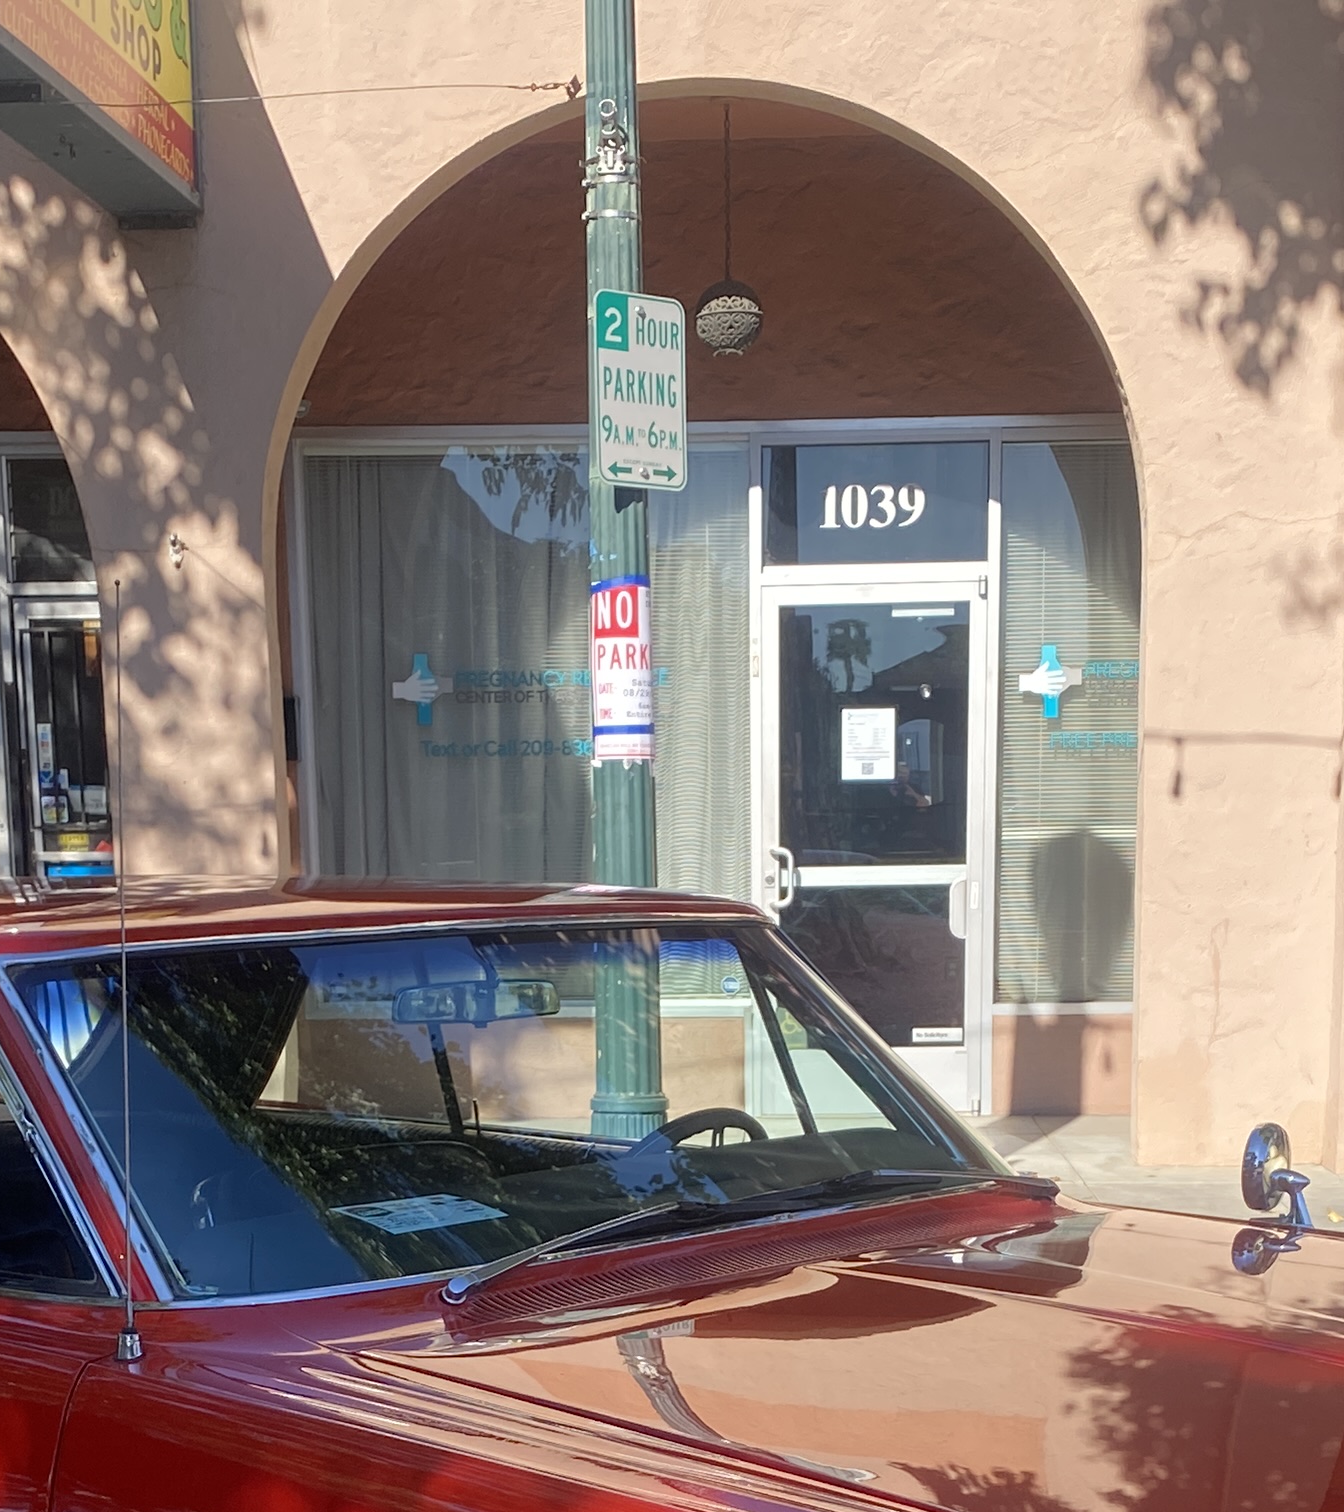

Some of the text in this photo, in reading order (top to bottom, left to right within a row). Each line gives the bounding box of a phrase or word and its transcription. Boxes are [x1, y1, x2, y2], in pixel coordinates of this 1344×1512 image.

[110, 0, 162, 81] SHOP
[604, 306, 680, 350] 2 HOUR
[603, 366, 677, 408] PARKING
[819, 484, 926, 529] 1039
[596, 589, 634, 630] NO
[455, 669, 564, 688] PREGNANCY
[455, 690, 512, 704] CENTER
[514, 690, 535, 704] OF
[419, 740, 456, 757] Text
[462, 743, 480, 757] or
[484, 739, 517, 757] Call
